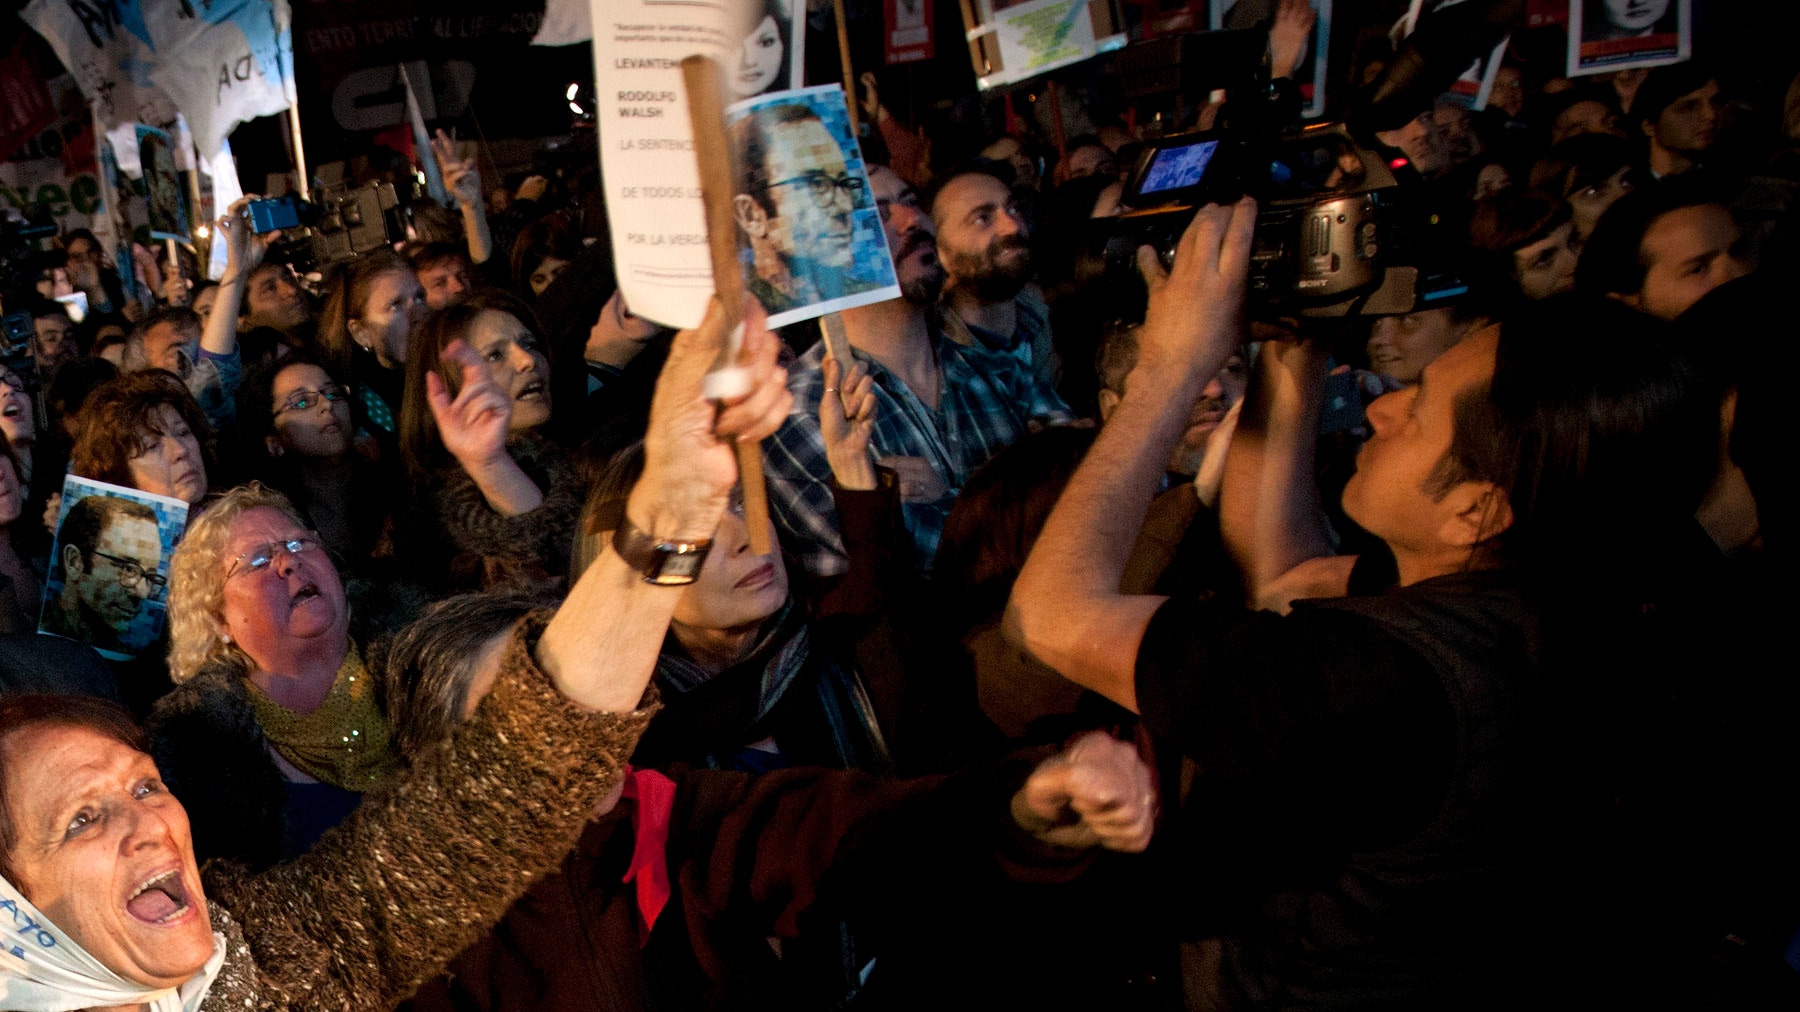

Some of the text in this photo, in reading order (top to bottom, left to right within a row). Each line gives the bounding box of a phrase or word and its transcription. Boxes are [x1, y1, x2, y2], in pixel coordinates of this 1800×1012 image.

[615, 58, 681, 69] LEVANTEM
[618, 91, 677, 102] RODOLFO
[619, 107, 664, 118] WALSH
[620, 139, 696, 151] LA SENTENC
[622, 187, 638, 198] DE
[642, 187, 683, 198] TODOS
[626, 233, 708, 245] POR LA VERDA
[1299, 280, 1328, 288] SONY
